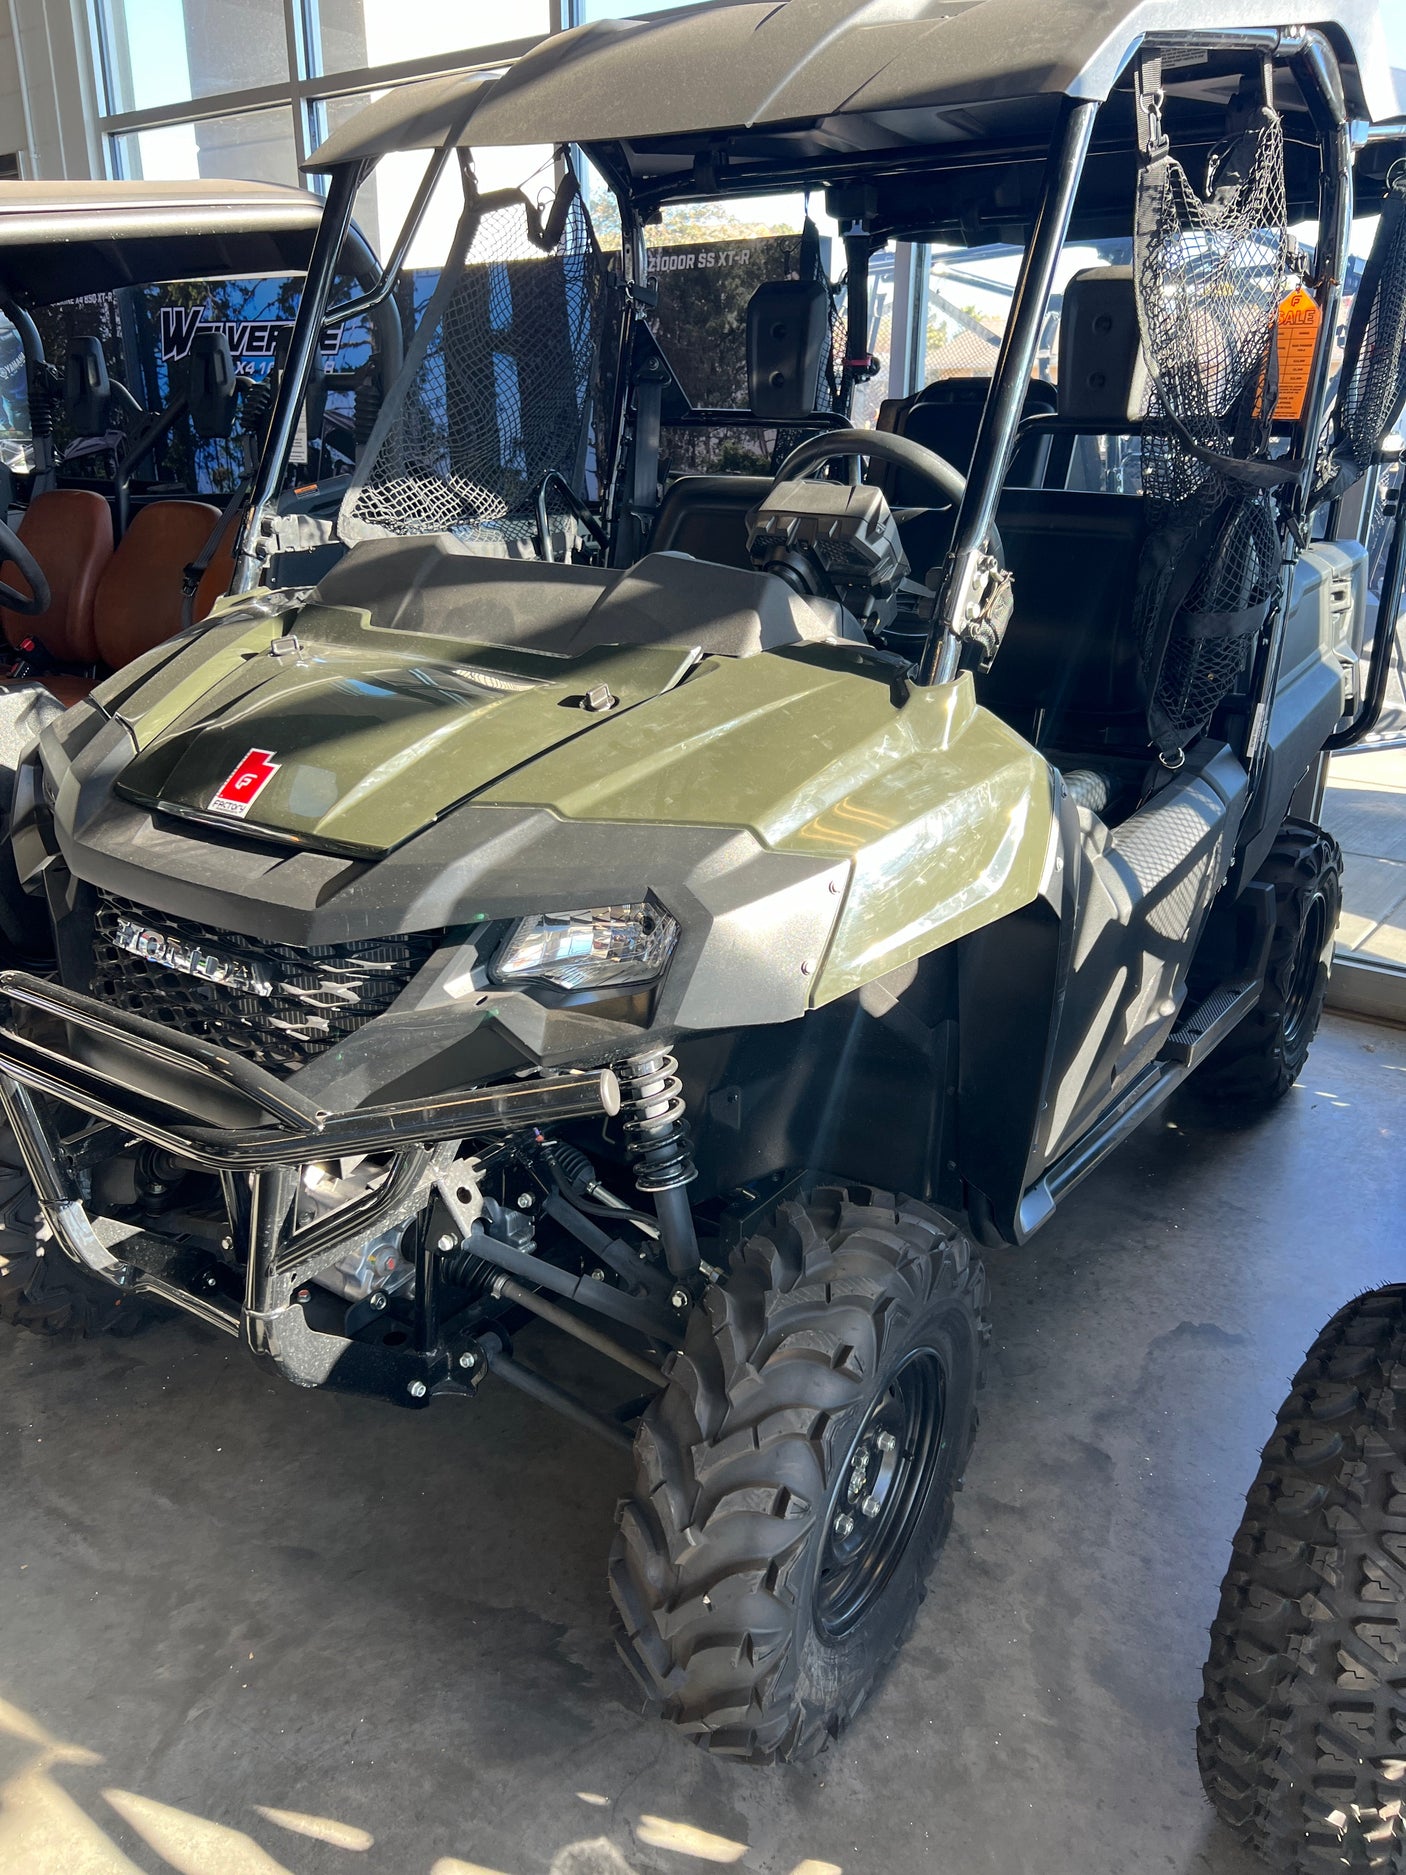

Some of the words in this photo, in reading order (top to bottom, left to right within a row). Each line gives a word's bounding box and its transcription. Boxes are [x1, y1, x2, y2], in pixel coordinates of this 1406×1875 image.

[698, 252, 715, 268] SS
[718, 249, 750, 267] XT-R
[160, 305, 345, 361] WVERE
[1278, 309, 1316, 326] SALE
[112, 917, 274, 996] HONDA
